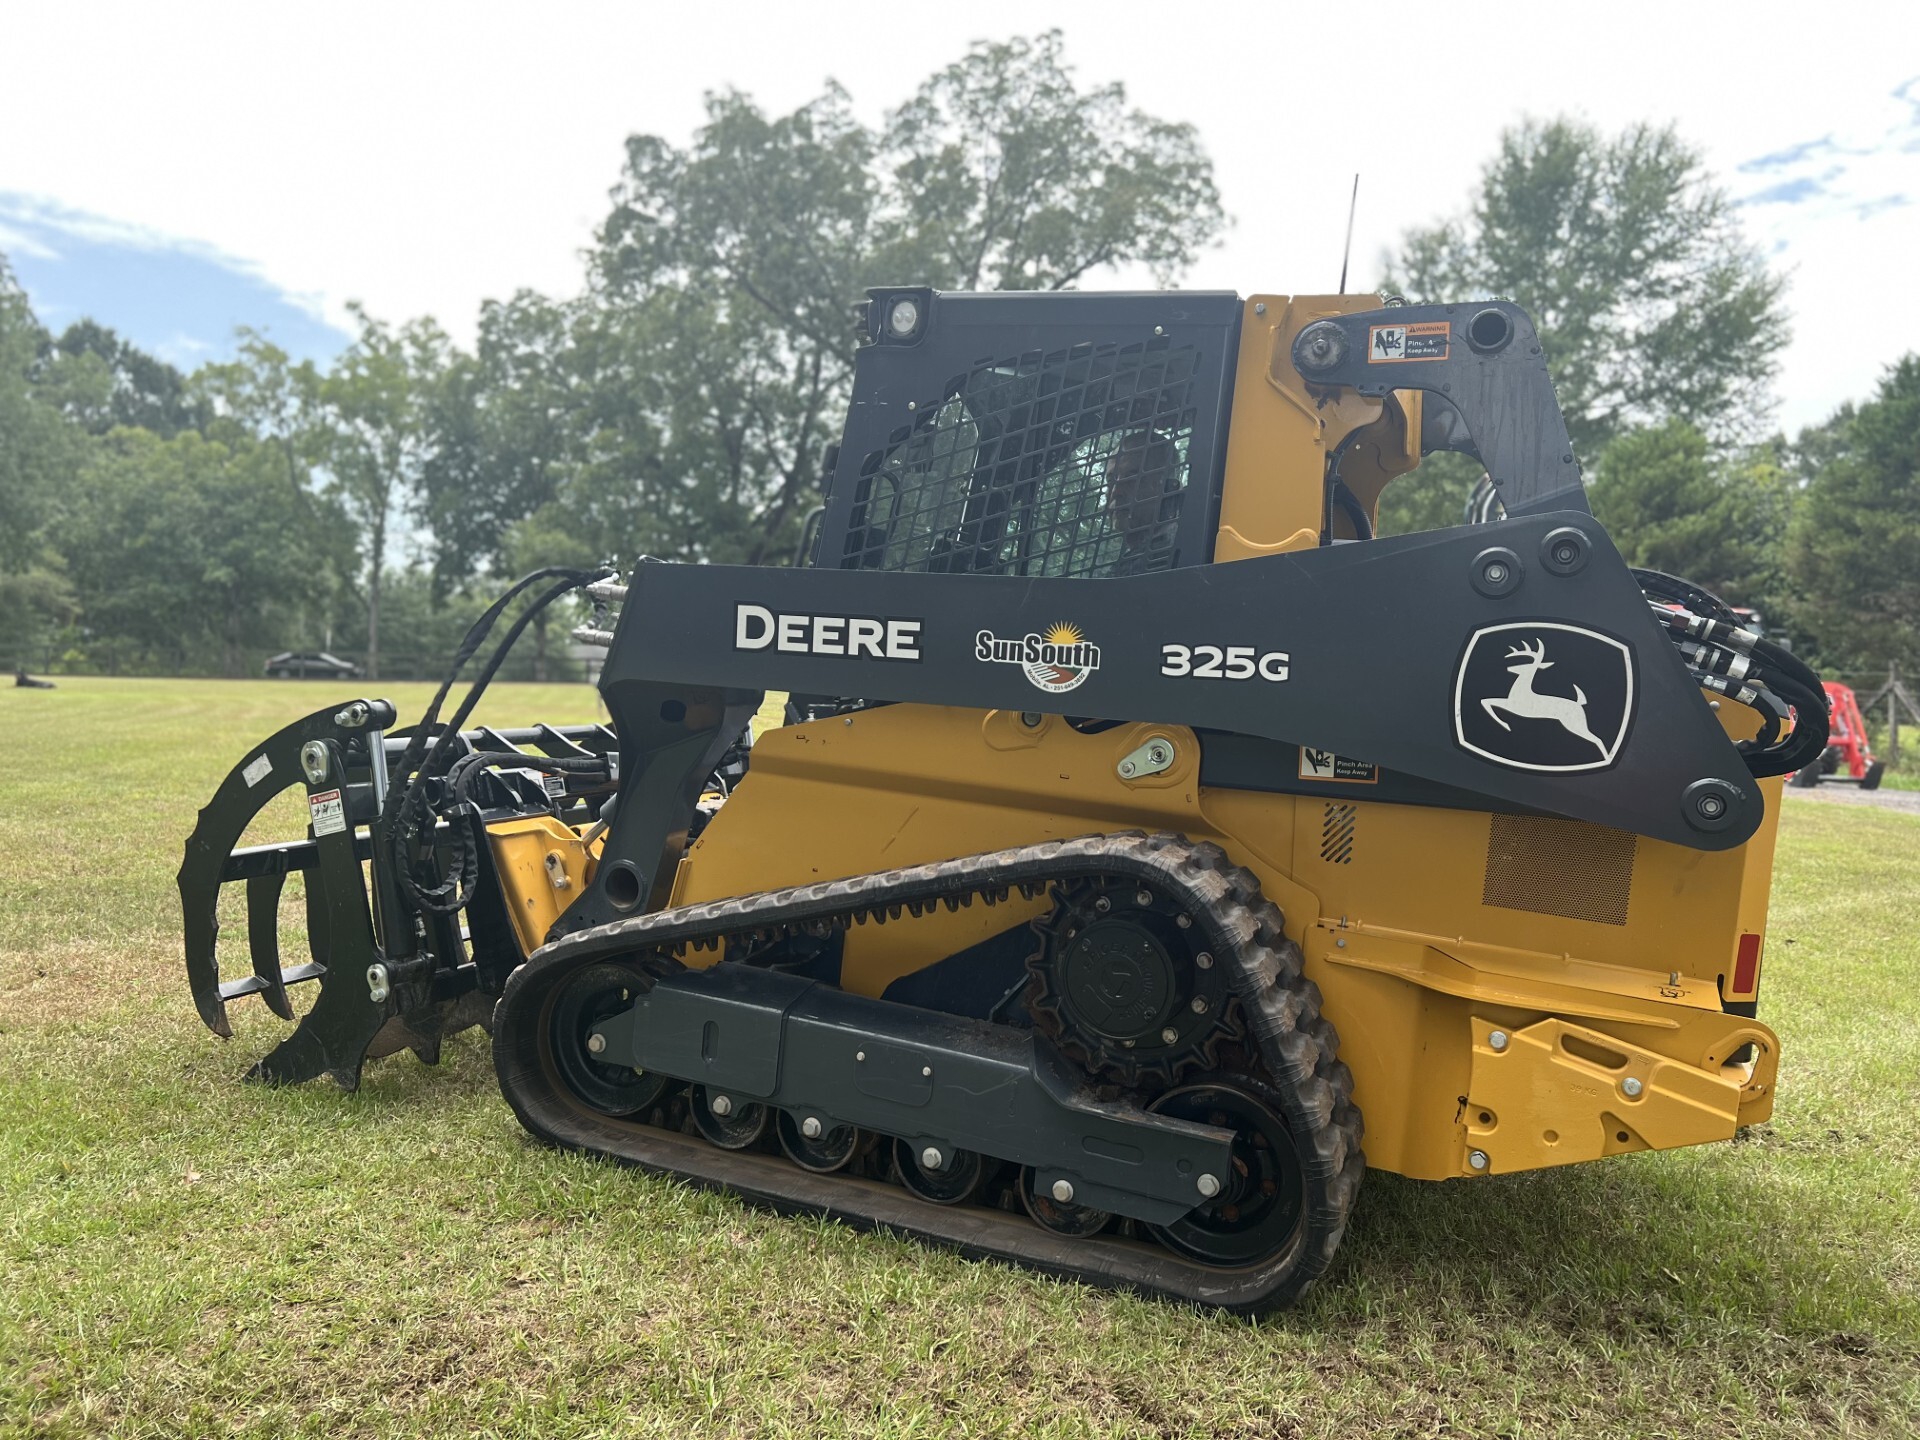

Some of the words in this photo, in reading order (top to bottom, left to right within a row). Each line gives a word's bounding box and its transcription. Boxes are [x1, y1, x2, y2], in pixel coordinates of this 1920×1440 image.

[736, 604, 921, 660] DEERE
[976, 630, 1100, 669] SunSouth
[1161, 644, 1289, 682] 325G
[1357, 761, 1373, 769] Area
[318, 792, 338, 801] DANGER
